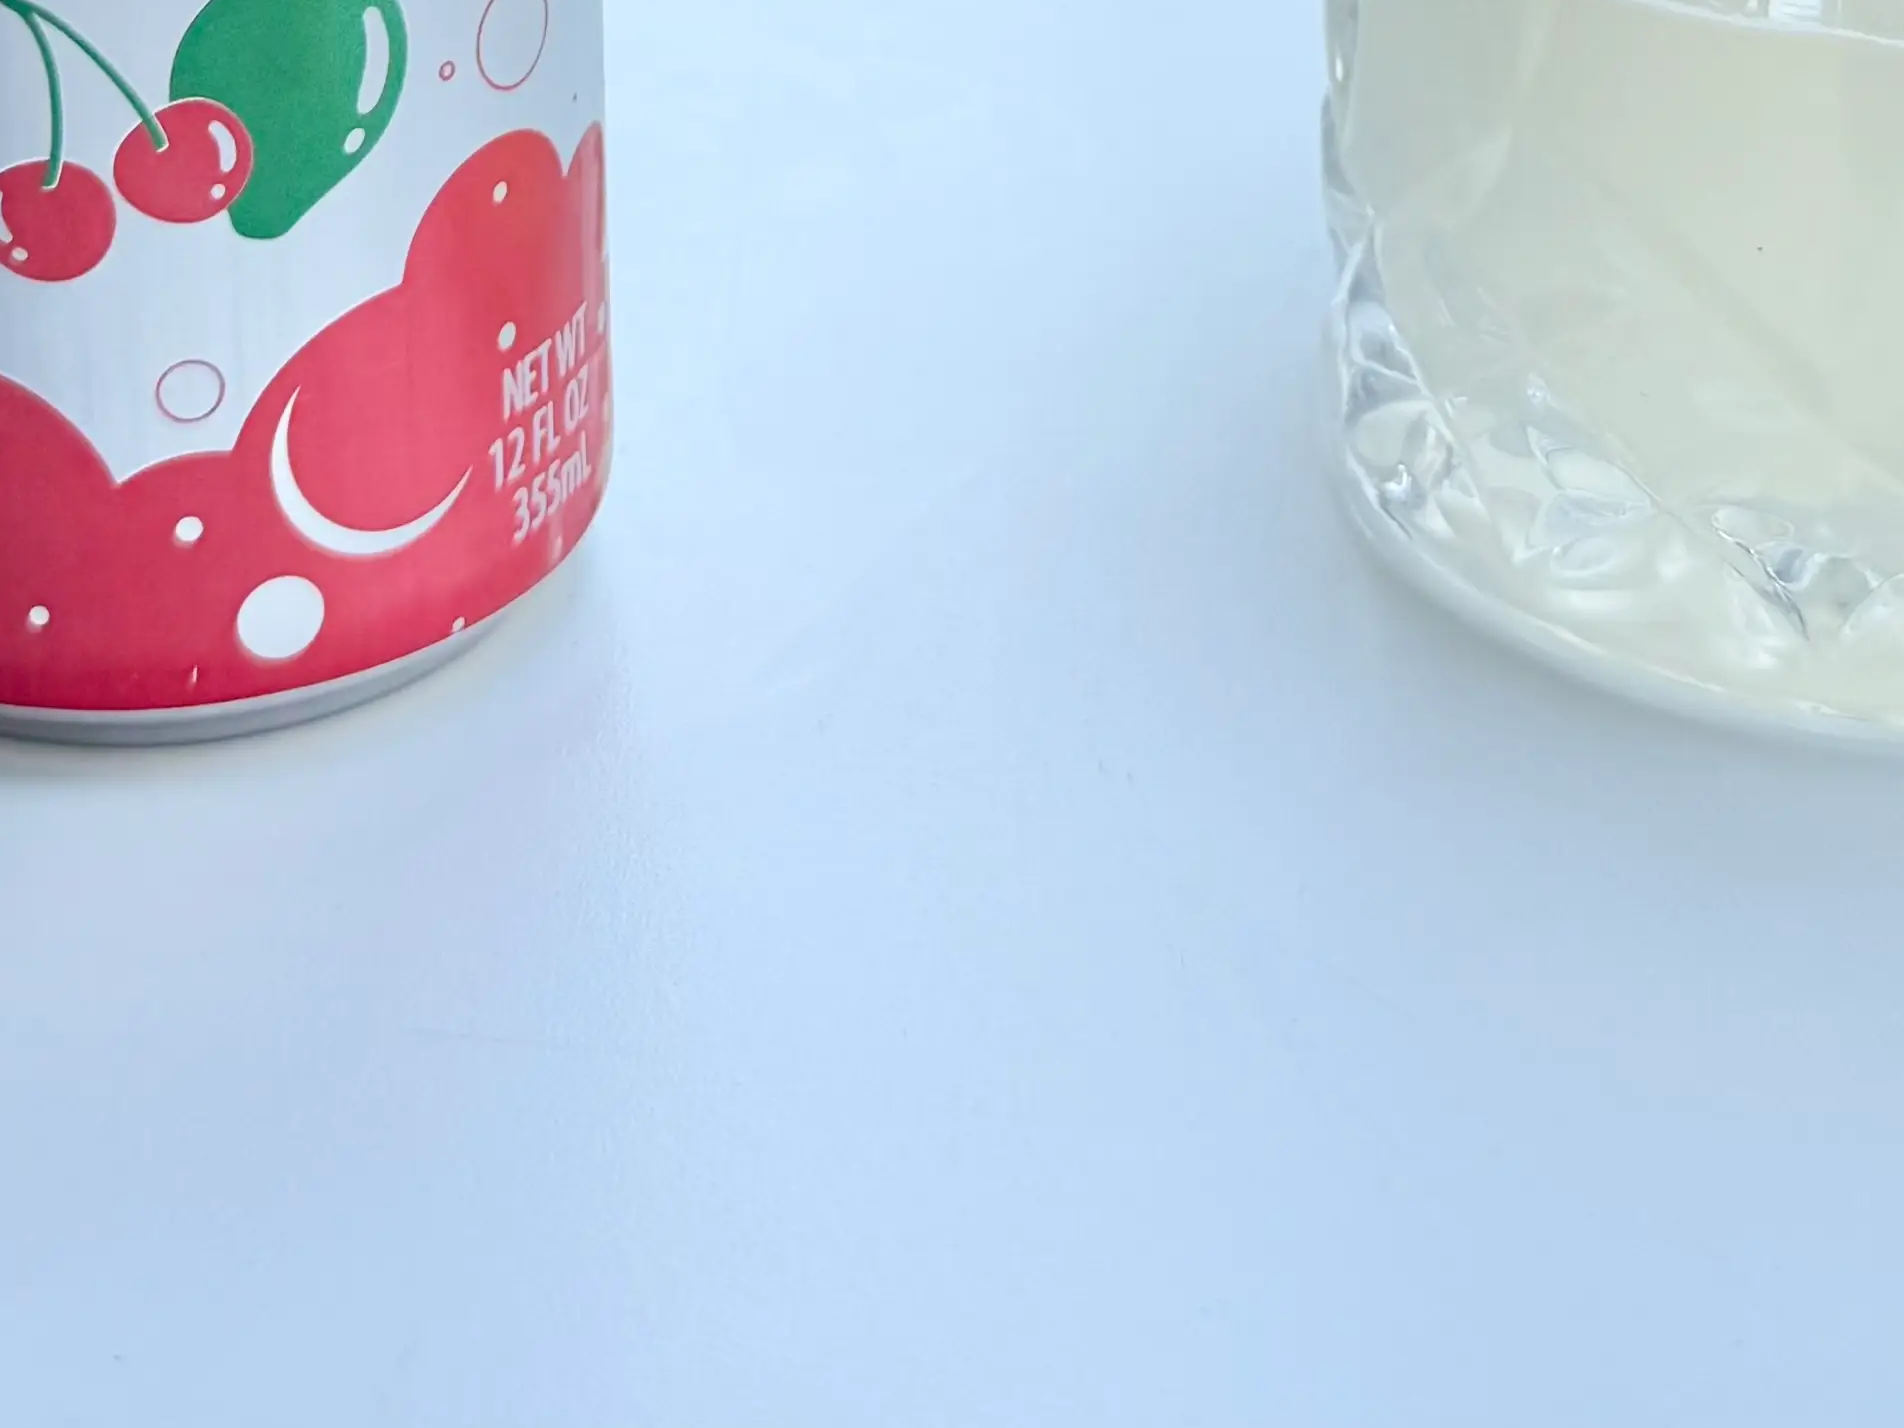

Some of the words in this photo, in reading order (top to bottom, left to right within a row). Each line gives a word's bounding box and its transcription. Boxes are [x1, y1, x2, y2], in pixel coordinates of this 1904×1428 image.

[501, 337, 552, 424] NET
[554, 300, 588, 377] WT
[488, 426, 526, 489] 12
[532, 400, 562, 464] FL
[563, 363, 590, 436] OZ
[511, 430, 592, 545] 355mL
